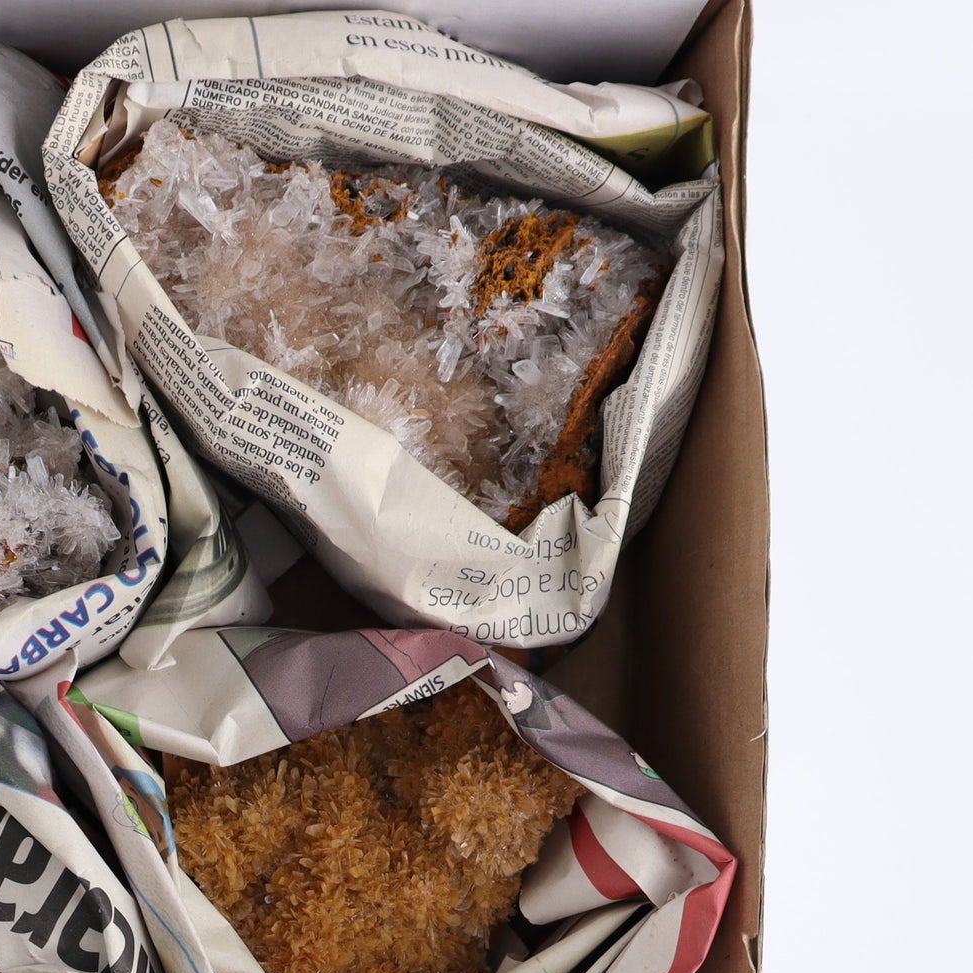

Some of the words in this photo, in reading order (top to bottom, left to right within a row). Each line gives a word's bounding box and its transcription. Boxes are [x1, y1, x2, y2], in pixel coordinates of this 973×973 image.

[346, 33, 378, 47] en
[384, 35, 438, 58] esos
[193, 86, 242, 105] NÚMERO
[246, 78, 299, 99] EDUARDO
[302, 94, 349, 115] GANDARA
[339, 93, 368, 111] Distrito
[197, 80, 259, 99] PUBLICADO
[263, 94, 278, 104] EN
[281, 98, 294, 108] LA
[296, 101, 324, 120] LISTA
[326, 114, 338, 124] EL
[341, 117, 370, 132] OCHO
[373, 127, 387, 138] DE
[389, 132, 421, 146] MARZO
[429, 106, 473, 139] ARNULFO
[525, 136, 564, 164] ADOLFO
[566, 163, 597, 187] COPAS
[573, 155, 604, 180] JAIME
[87, 225, 106, 250] TITO
[140, 321, 161, 347] para
[149, 303, 196, 348] contrata-
[194, 348, 209, 364] de
[159, 348, 194, 390] oficiales
[197, 369, 234, 410] tamaño,
[194, 388, 224, 420] pocos
[252, 405, 268, 422] de
[282, 404, 301, 418] un
[247, 421, 272, 440] son
[267, 413, 309, 441] ciudad
[305, 412, 340, 442] iniciar
[231, 434, 284, 467] oficiales,
[273, 433, 326, 468] cantidad,
[310, 437, 332, 454] una
[286, 460, 305, 479] los
[305, 464, 321, 484] de
[467, 531, 500, 550] con
